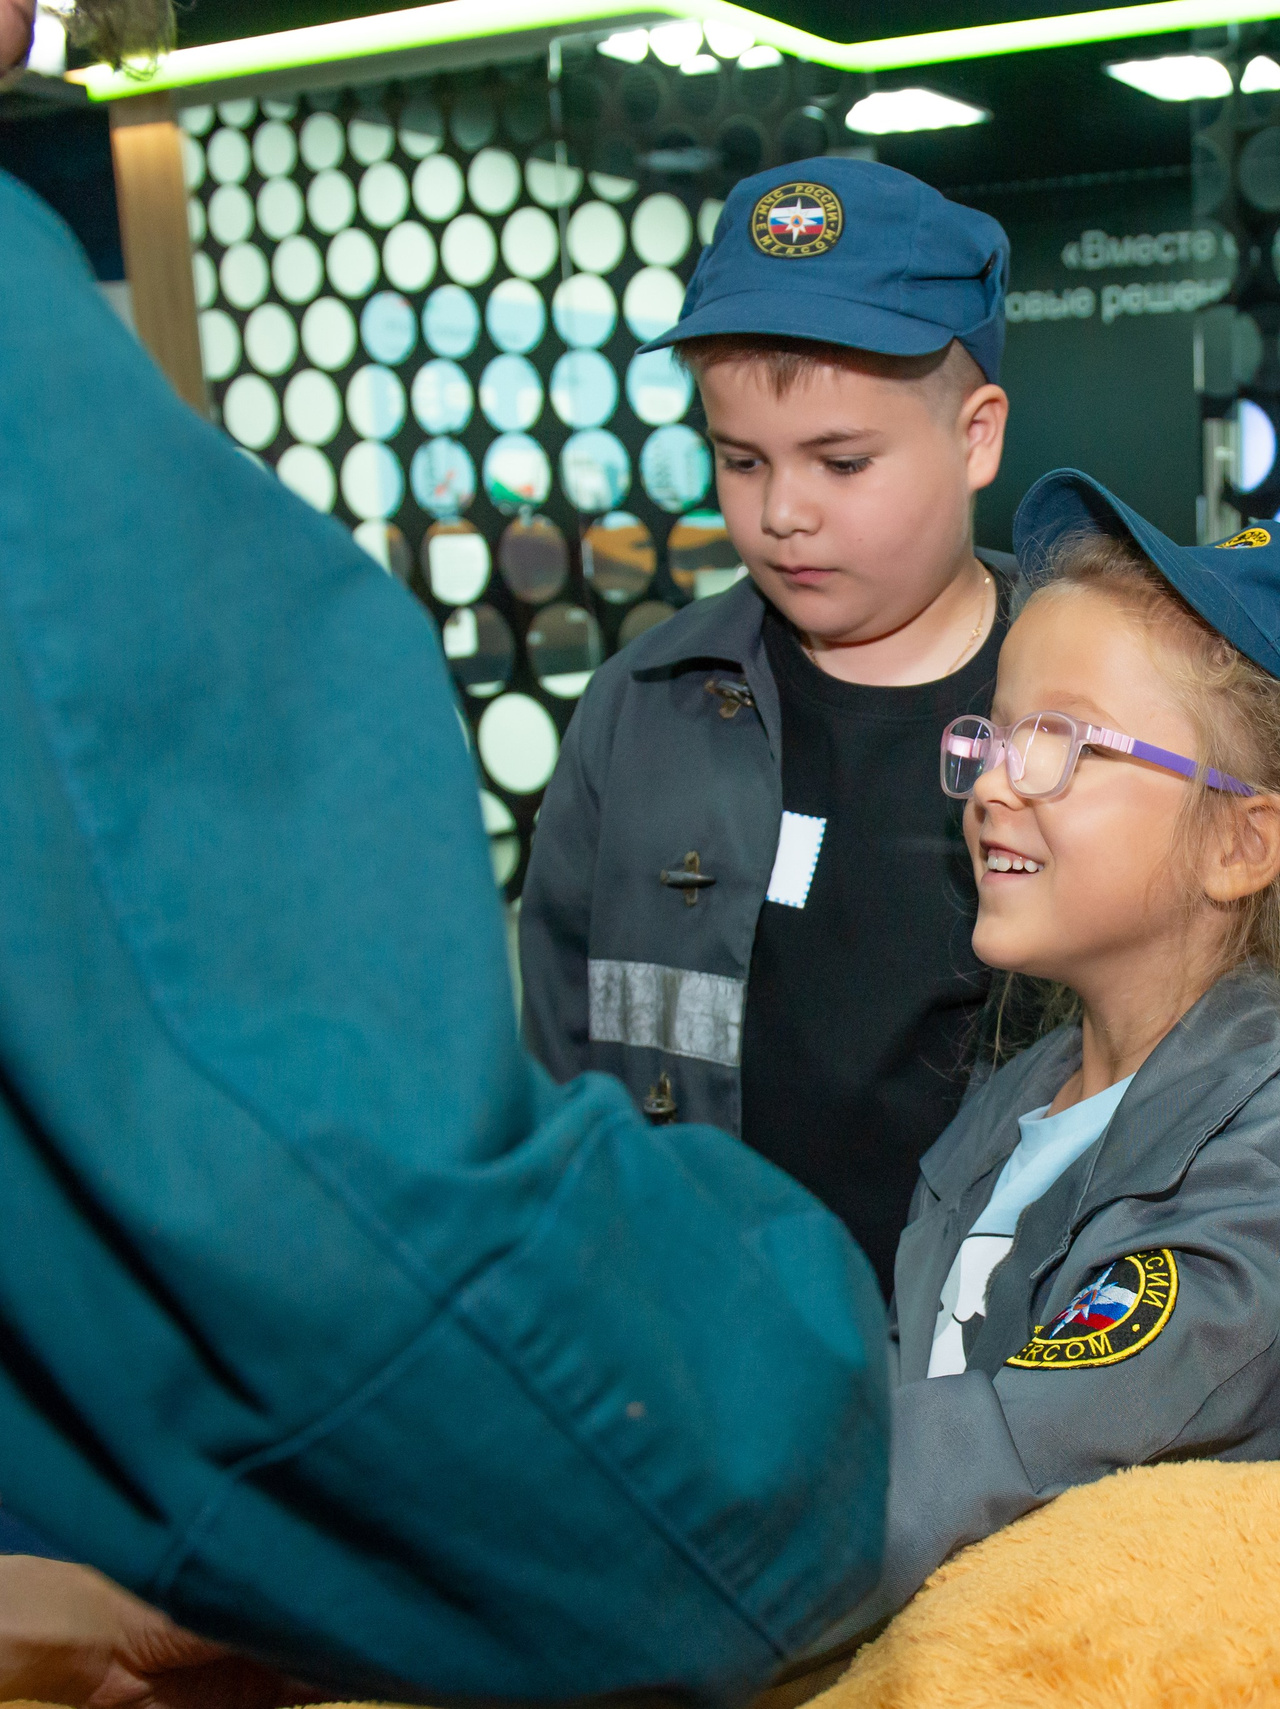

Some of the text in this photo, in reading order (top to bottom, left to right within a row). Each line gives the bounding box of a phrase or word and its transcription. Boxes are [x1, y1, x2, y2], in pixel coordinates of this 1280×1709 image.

[758, 185, 838, 221] МЧС РОССИИ
[756, 222, 837, 254] EMERCOM
[1005, 287, 1096, 323] овые
[1138, 1251, 1169, 1309] СИИ
